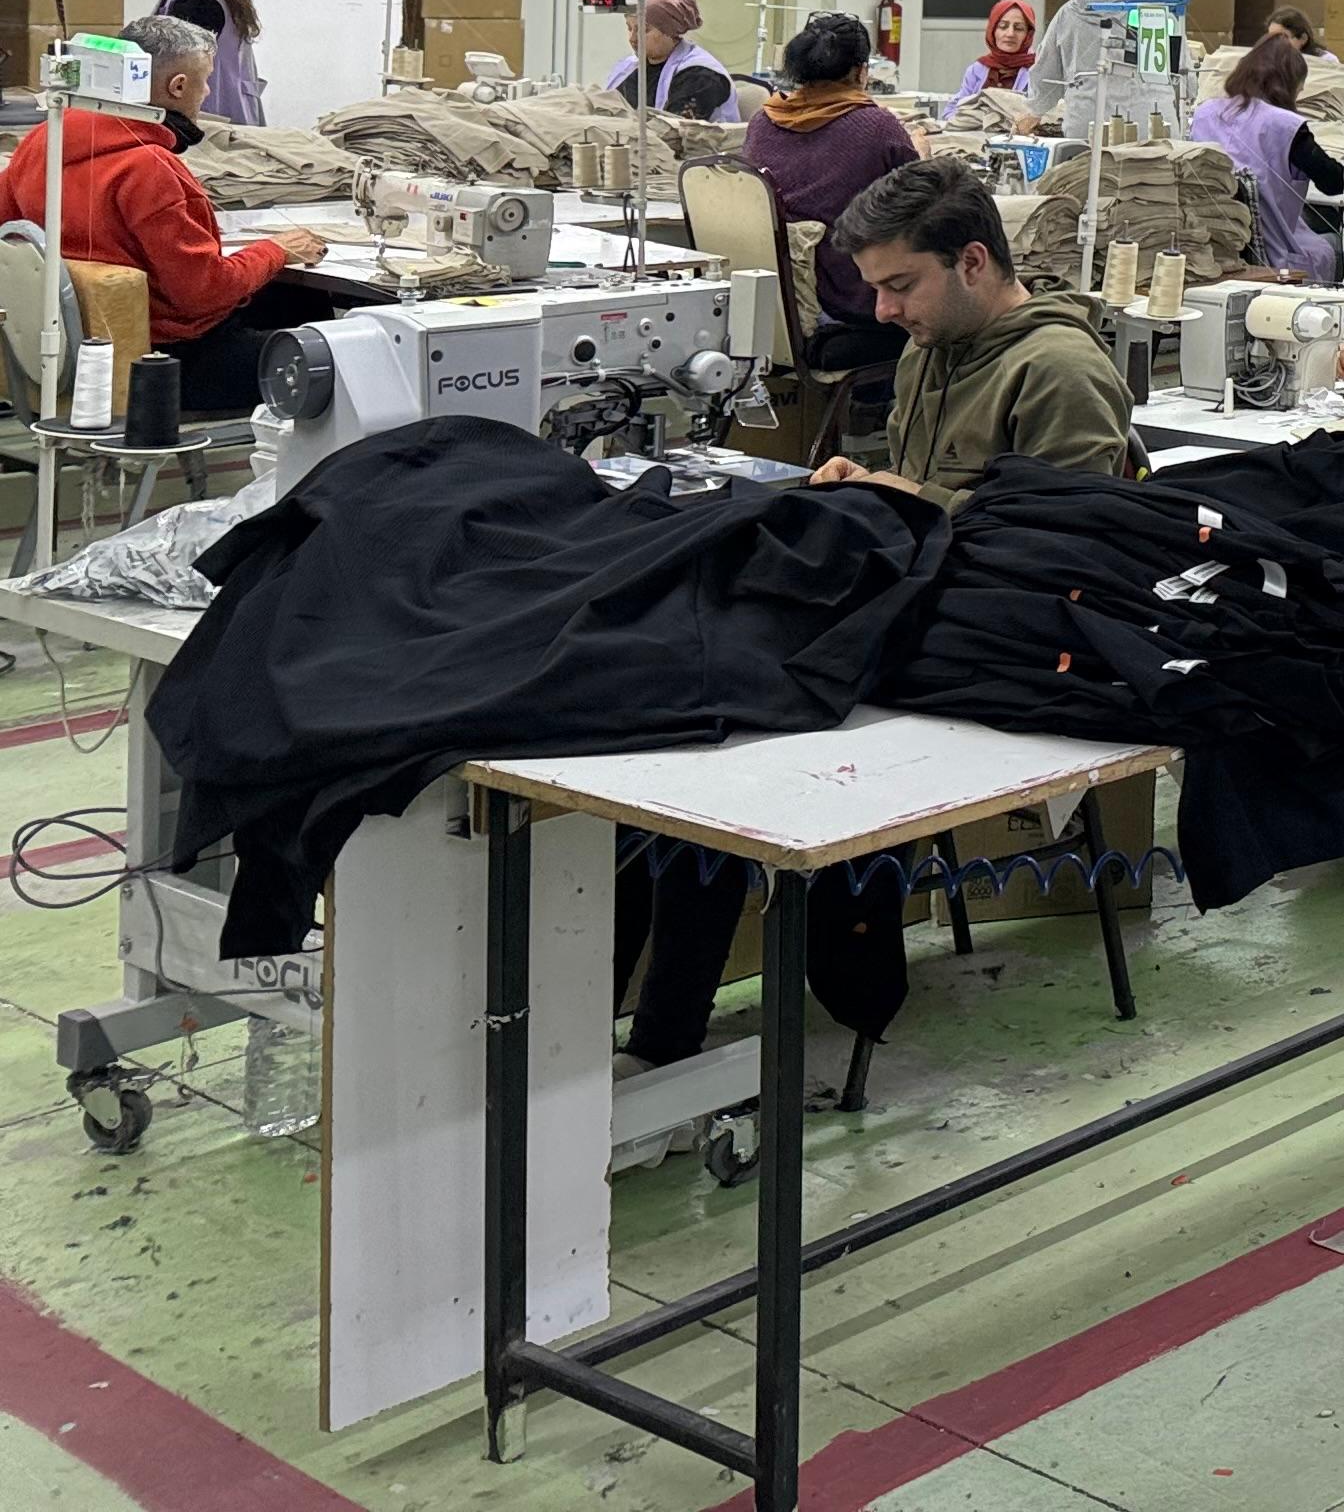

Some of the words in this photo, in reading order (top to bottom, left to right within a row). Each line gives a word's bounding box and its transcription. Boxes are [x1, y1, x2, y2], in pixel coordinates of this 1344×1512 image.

[1140, 28, 1167, 73] 75
[437, 368, 520, 395] FOCUS
[233, 955, 324, 1011] FOCU
